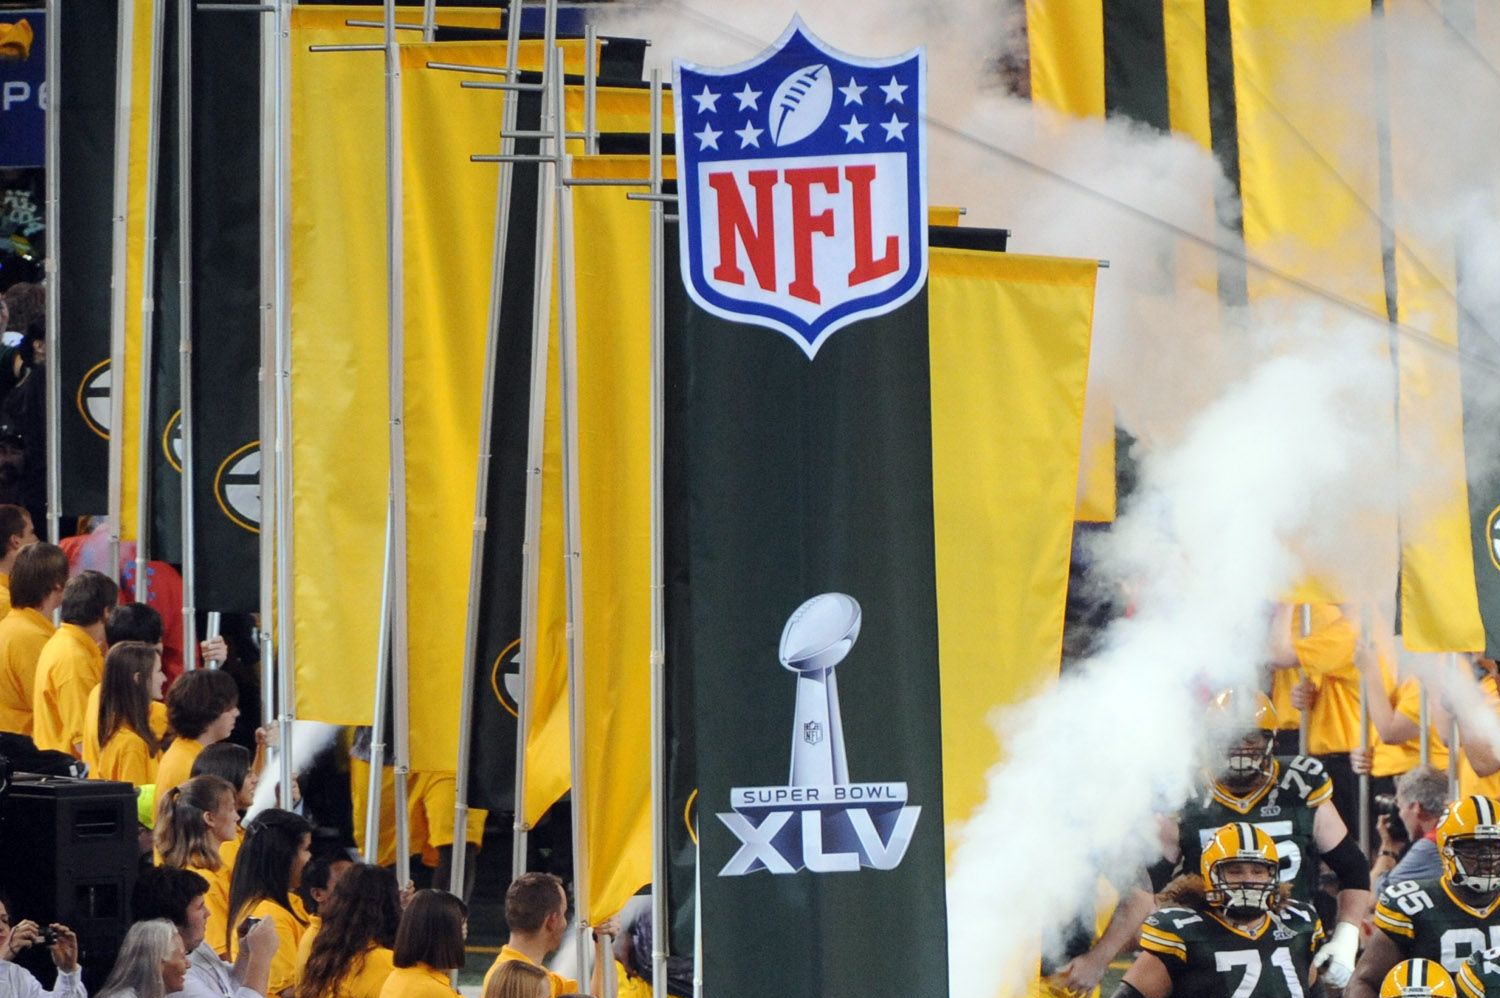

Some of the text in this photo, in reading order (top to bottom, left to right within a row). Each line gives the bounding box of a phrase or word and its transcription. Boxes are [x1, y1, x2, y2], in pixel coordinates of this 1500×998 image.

[708, 164, 900, 305] NFL
[743, 785, 897, 804] SUPER BOWL
[715, 805, 922, 876] XLV
